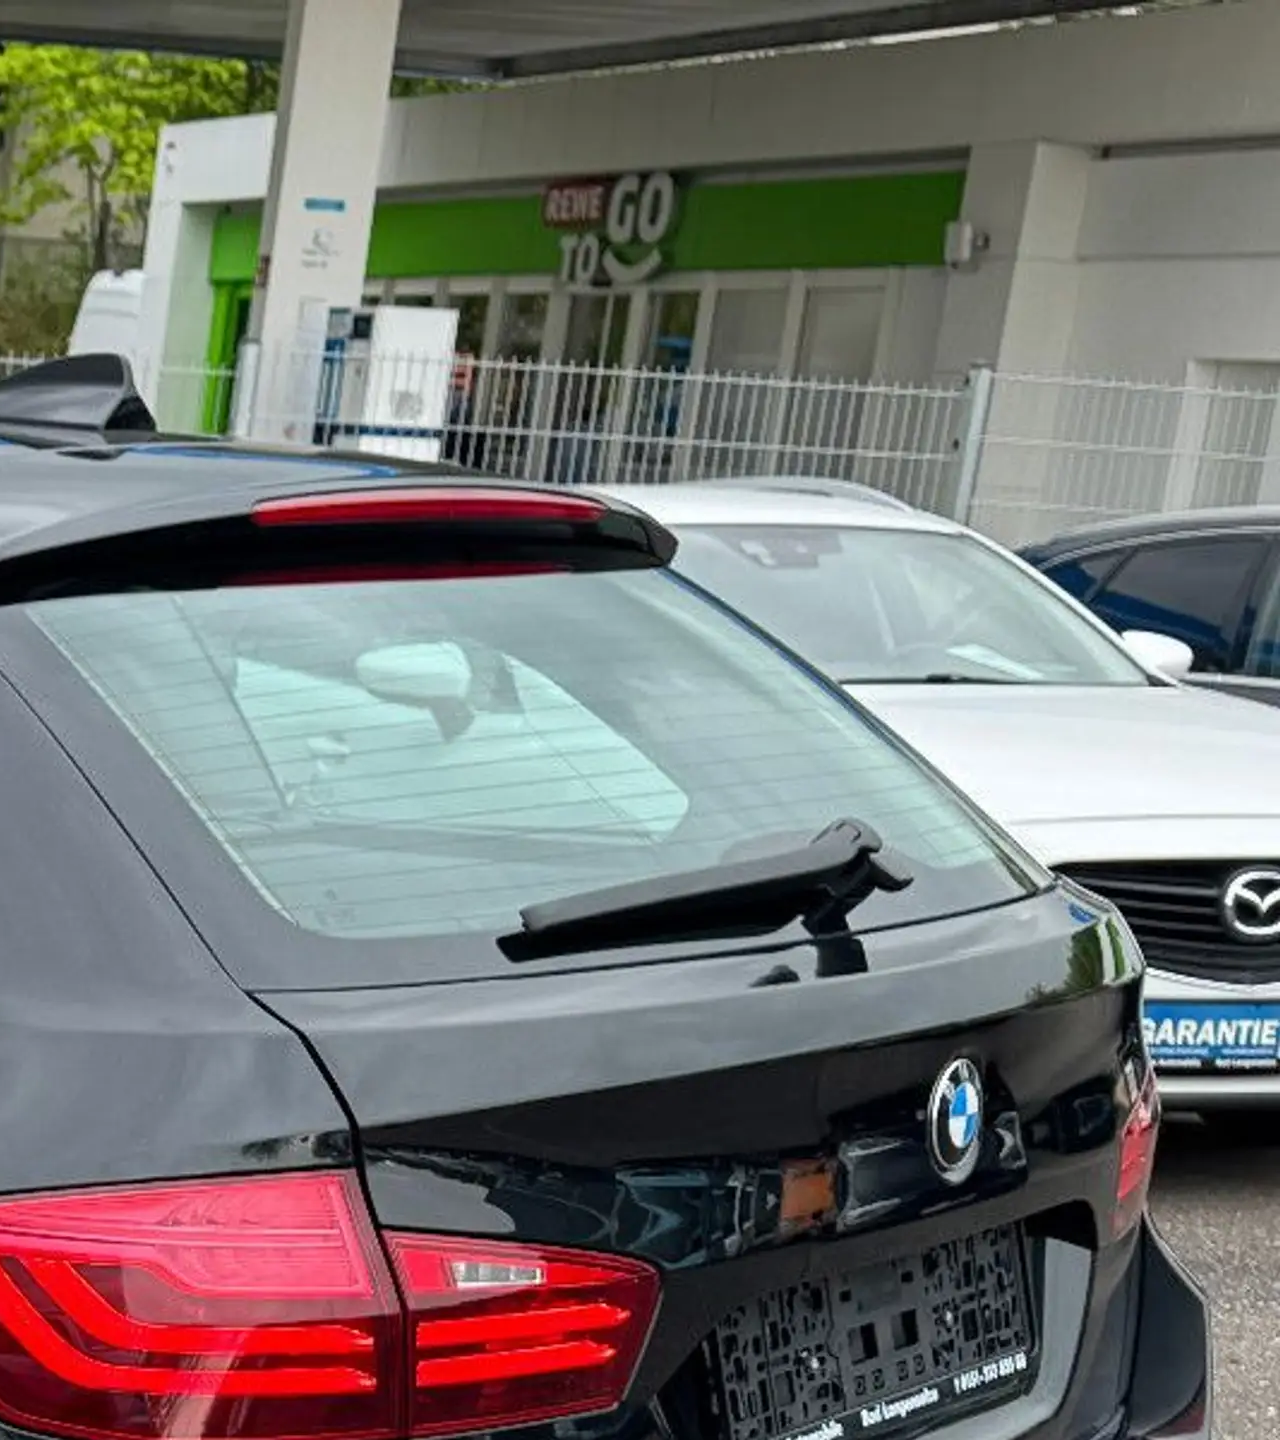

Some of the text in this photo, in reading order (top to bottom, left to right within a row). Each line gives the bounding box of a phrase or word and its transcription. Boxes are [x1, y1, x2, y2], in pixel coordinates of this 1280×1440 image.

[545, 171, 674, 244] REWE GO
[558, 232, 600, 284] TO
[1142, 1017, 1279, 1046] GARANTIE
